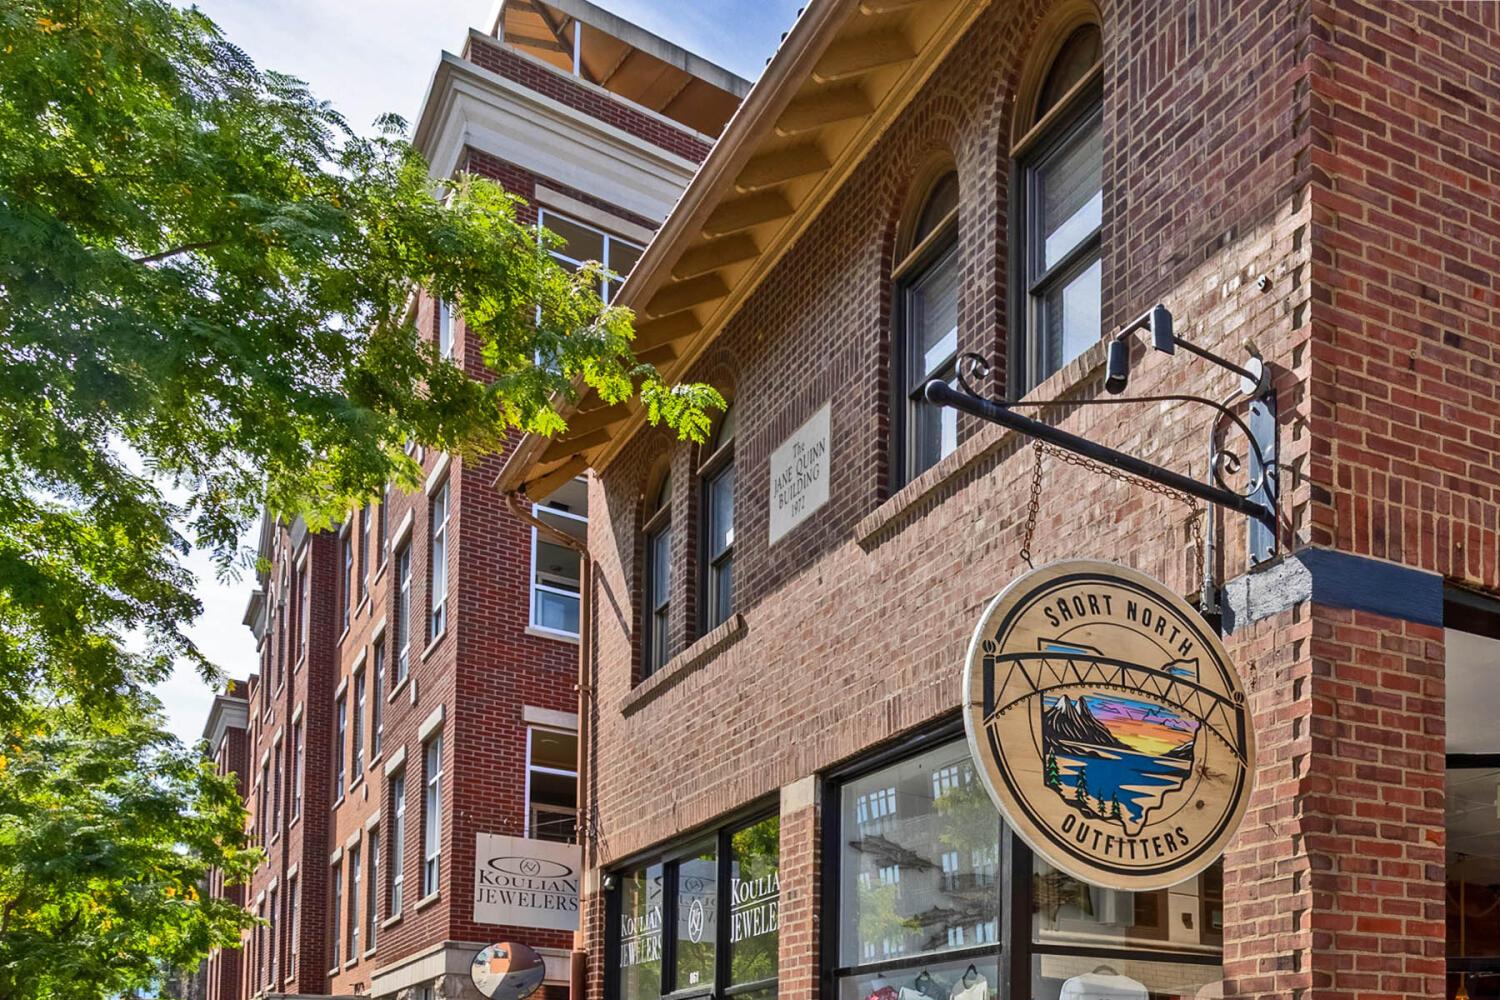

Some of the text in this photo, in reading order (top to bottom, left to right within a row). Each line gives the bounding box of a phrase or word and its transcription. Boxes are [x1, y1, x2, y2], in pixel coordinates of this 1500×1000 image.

[774, 438, 826, 497] JANE QUINN
[779, 464, 819, 509] BUILDING
[1044, 594, 1193, 656] SHORT NORTH
[1061, 813, 1189, 860] OUTFITTERS
[476, 888, 578, 912] JEWELERS
[480, 870, 578, 892] KOULIAN
[730, 901, 780, 943] JEWELE
